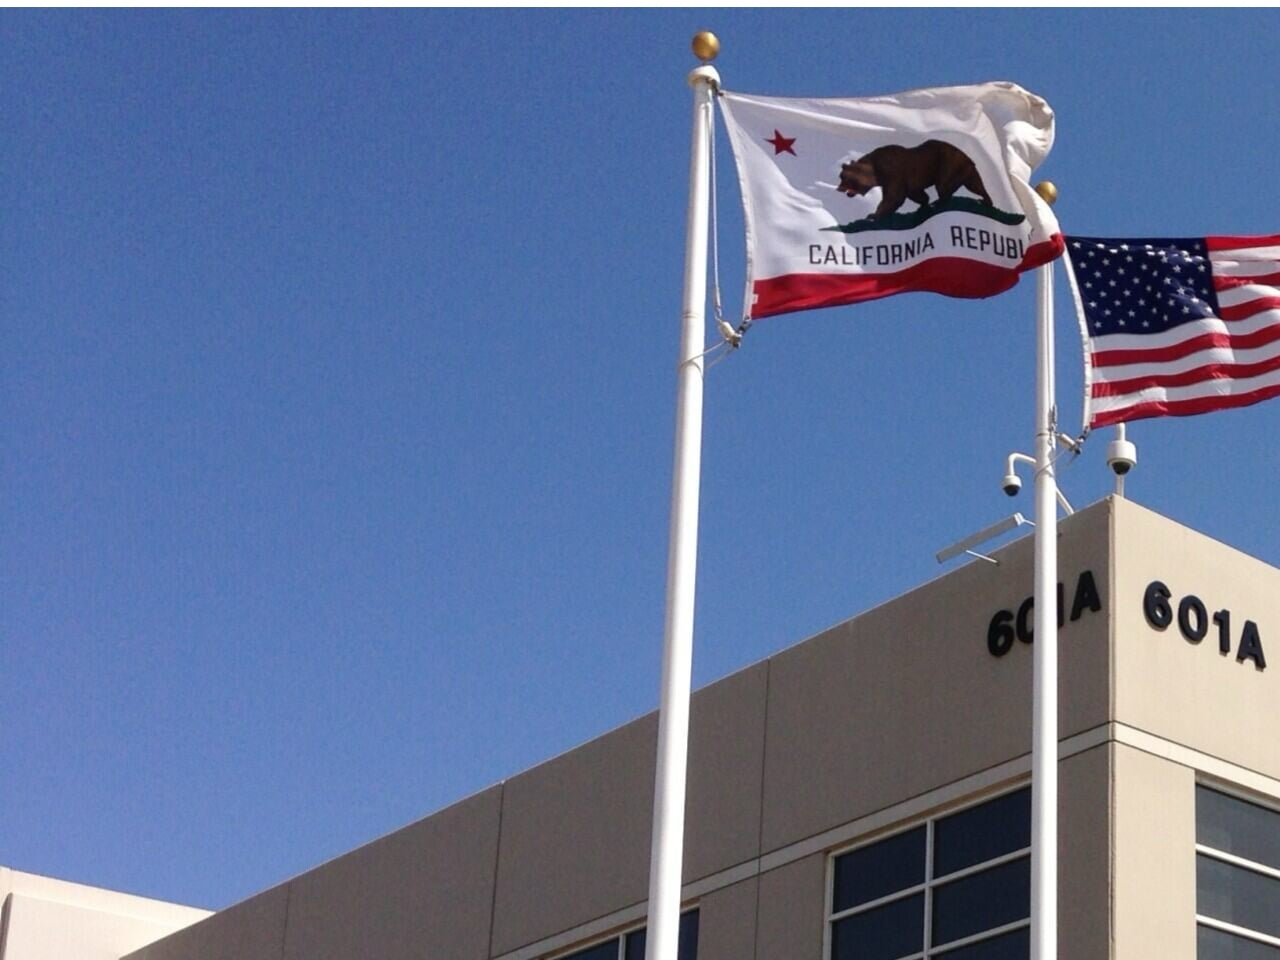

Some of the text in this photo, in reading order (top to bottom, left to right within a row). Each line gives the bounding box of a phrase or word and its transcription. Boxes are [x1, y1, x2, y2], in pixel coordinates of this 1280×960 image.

[809, 225, 1026, 265] CALIFORNIA REPUBL
[987, 570, 1102, 657] 601A
[1143, 580, 1266, 671] 601A
